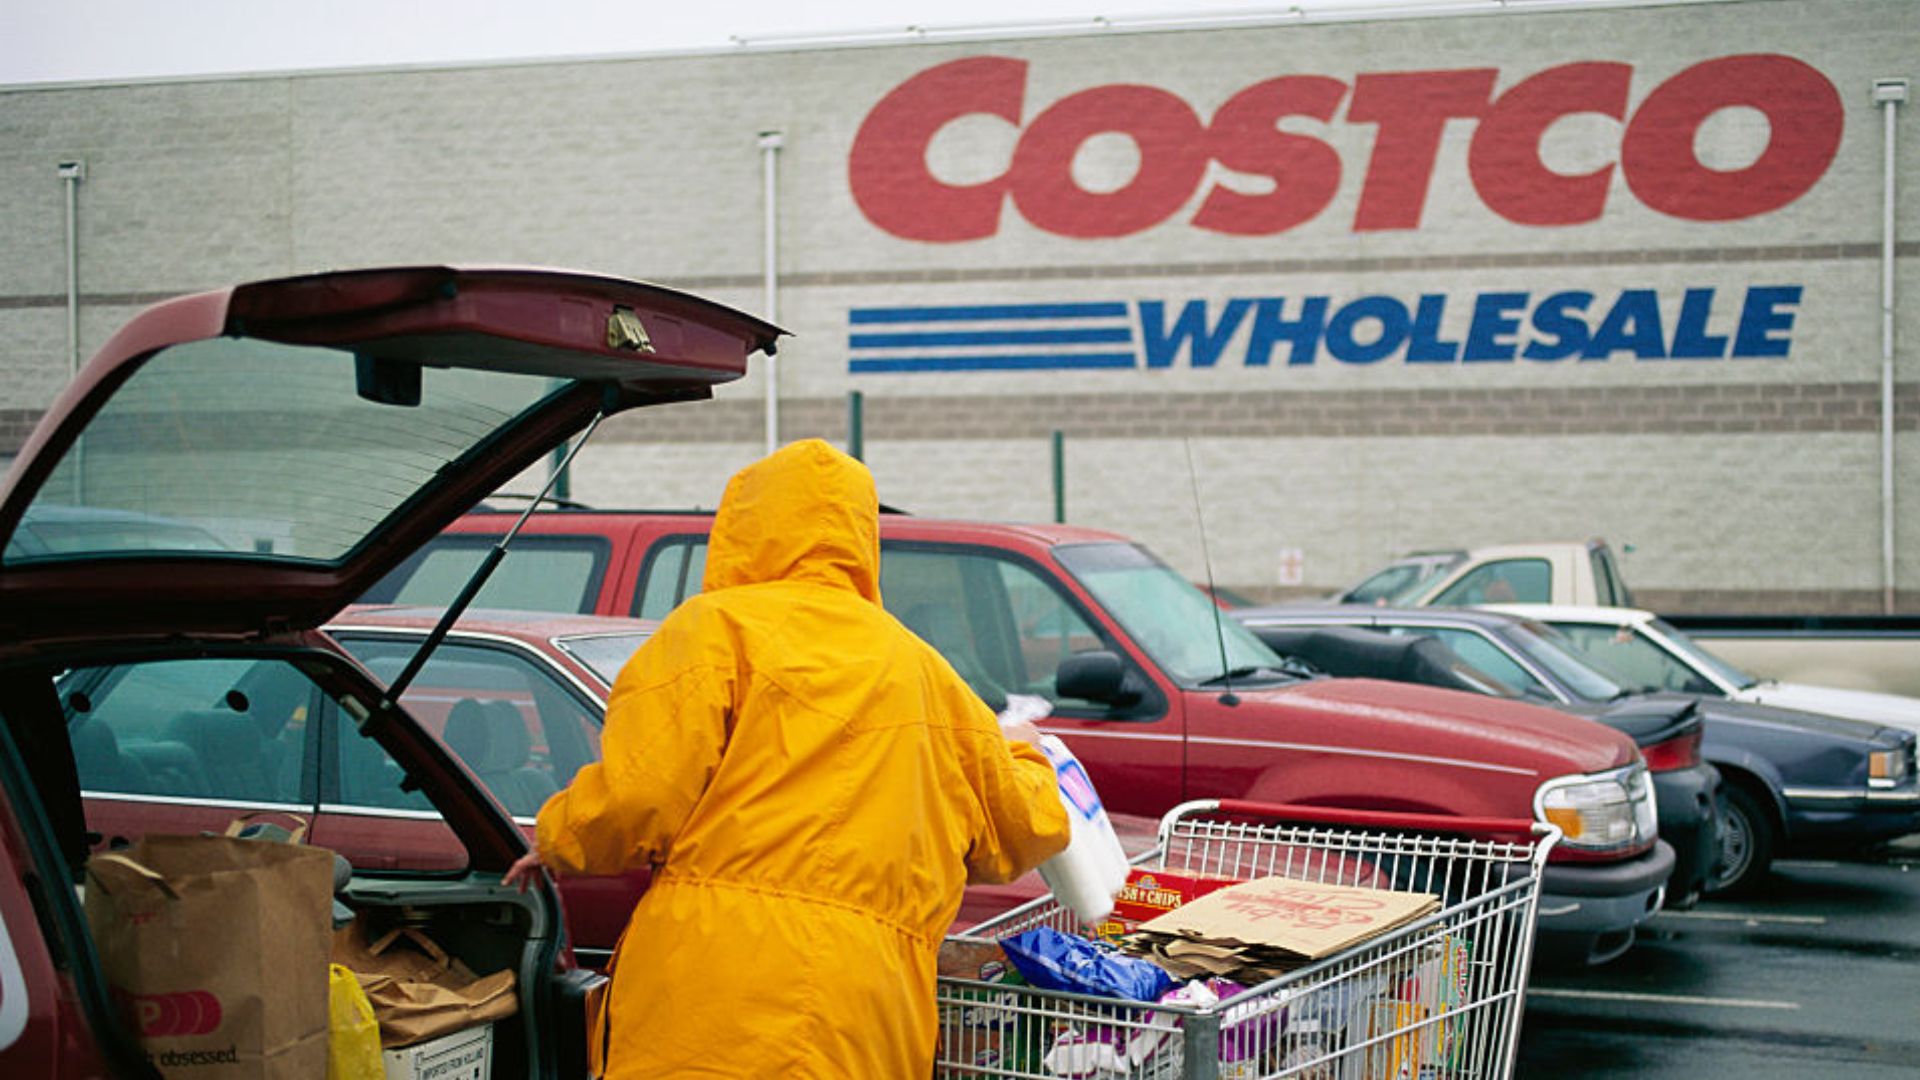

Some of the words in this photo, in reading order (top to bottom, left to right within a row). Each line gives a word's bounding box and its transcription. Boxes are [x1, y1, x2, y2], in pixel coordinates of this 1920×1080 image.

[849, 53, 1843, 243] COSTCO
[1139, 286, 1803, 369] WHOLESALE
[1117, 885, 1138, 902] ISH
[1147, 890, 1182, 908] CHIPS
